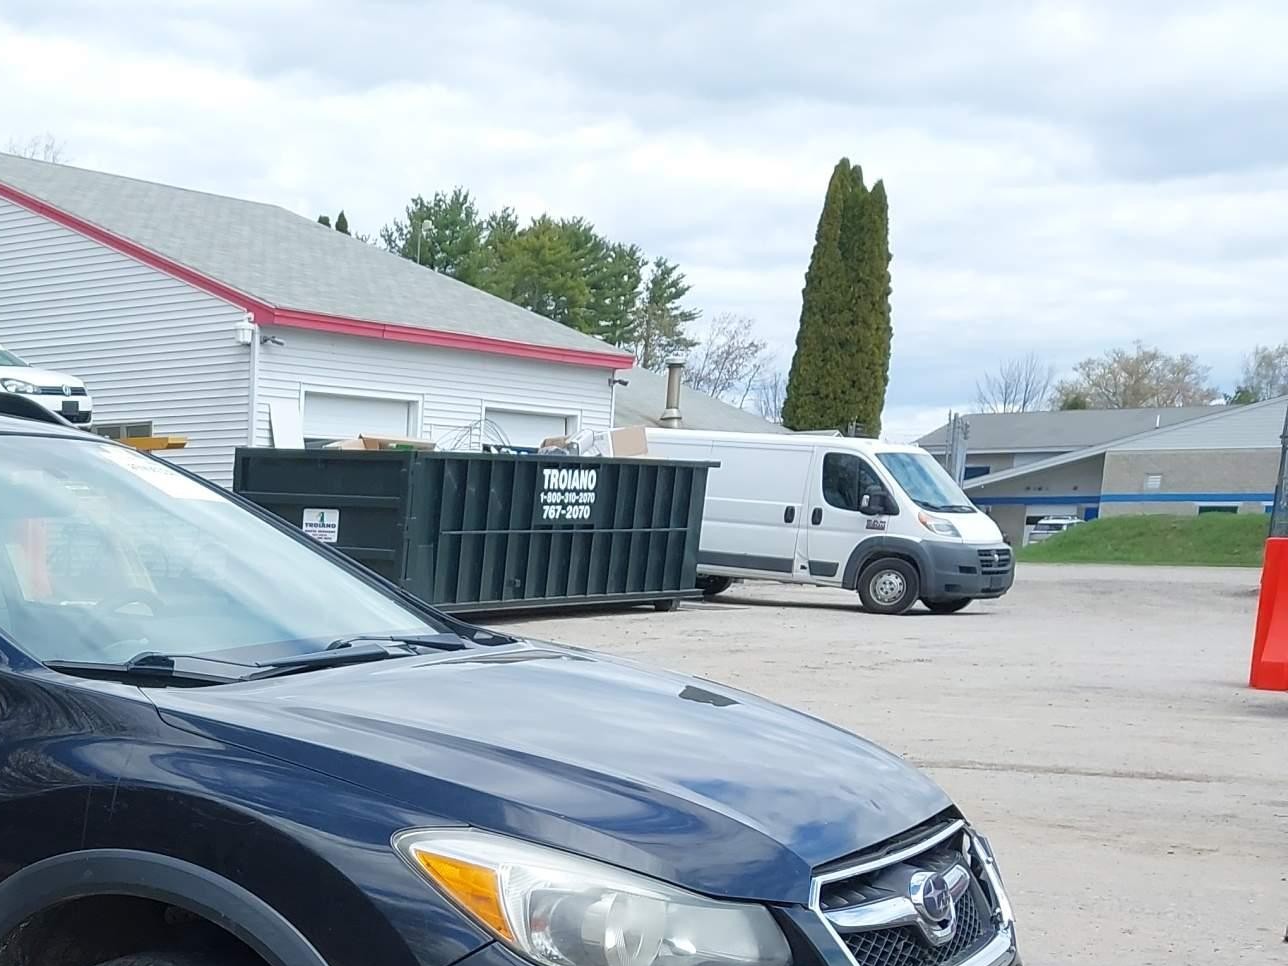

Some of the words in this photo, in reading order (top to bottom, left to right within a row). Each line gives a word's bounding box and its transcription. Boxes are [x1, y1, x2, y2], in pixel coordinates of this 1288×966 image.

[543, 468, 597, 490] TROIANO
[540, 491, 596, 503] 1-800-310-2070
[542, 505, 591, 519] 767-2070
